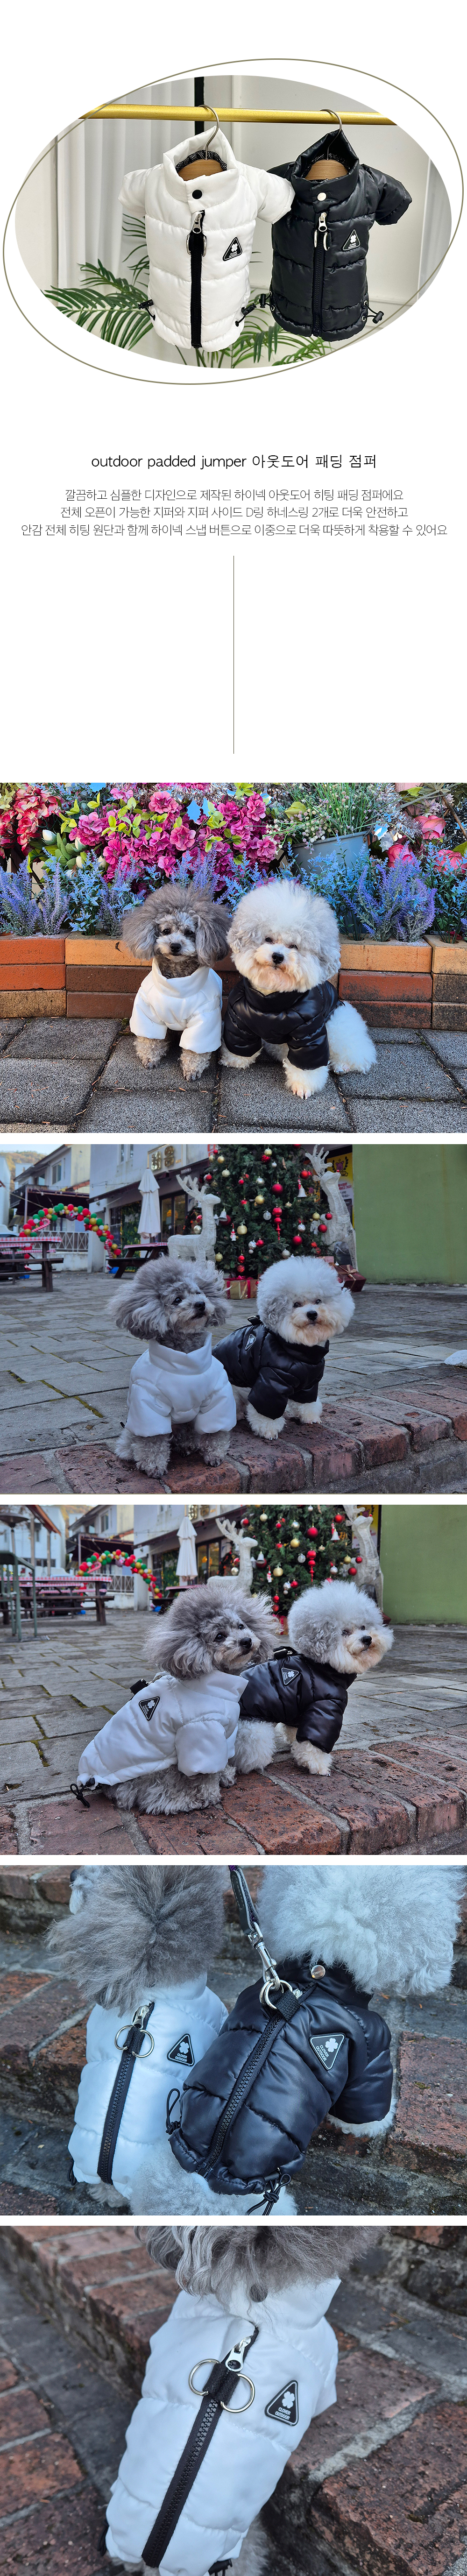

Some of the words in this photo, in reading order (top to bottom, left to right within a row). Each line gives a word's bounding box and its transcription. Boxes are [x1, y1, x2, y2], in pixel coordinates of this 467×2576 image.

[316, 2046, 327, 2061] OUTDOOR
[319, 2045, 329, 2058] CLOVER
[275, 2411, 290, 2420] OUTDOOR
[278, 2407, 291, 2415] CLOVER
